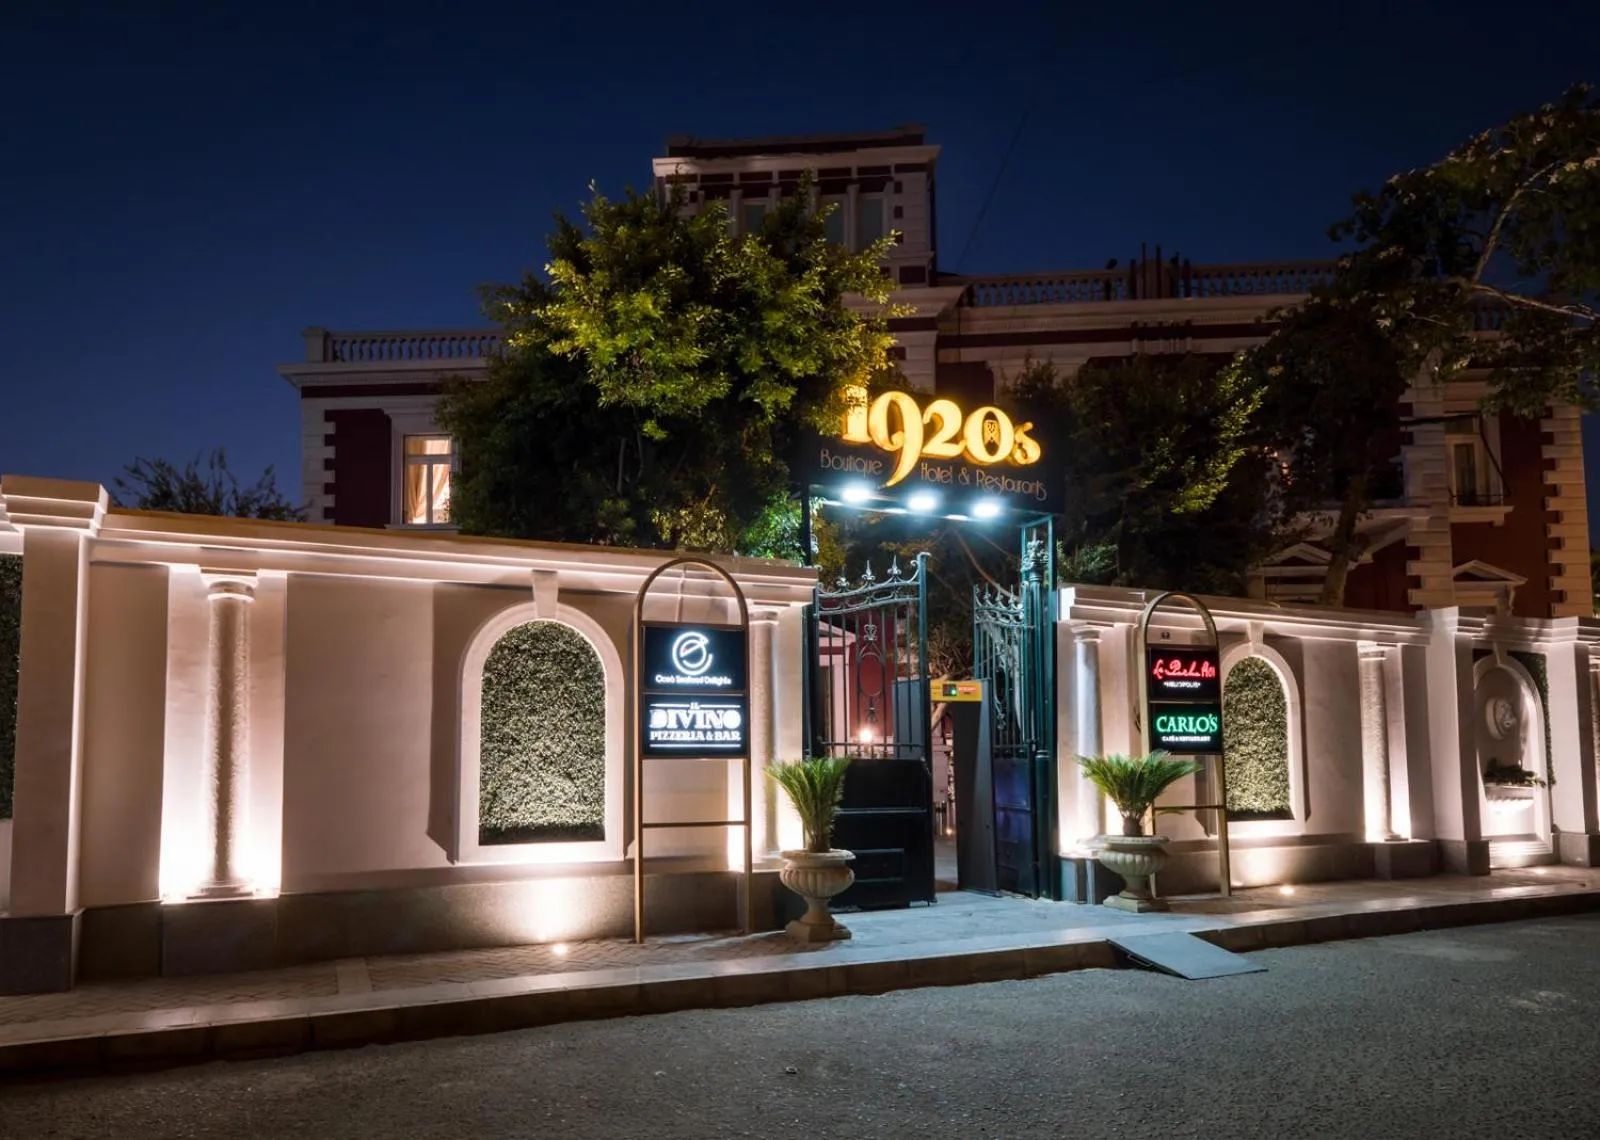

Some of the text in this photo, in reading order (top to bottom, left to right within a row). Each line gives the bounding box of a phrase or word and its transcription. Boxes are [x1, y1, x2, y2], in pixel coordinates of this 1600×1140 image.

[839, 384, 1042, 488] 1920s
[819, 449, 883, 478] Boutique
[921, 462, 953, 484] Hotel
[958, 467, 970, 485] &
[649, 709, 741, 729] DIVINO
[1156, 713, 1218, 734] CARLO'S
[650, 731, 741, 741] PIZZERIA & BAR
